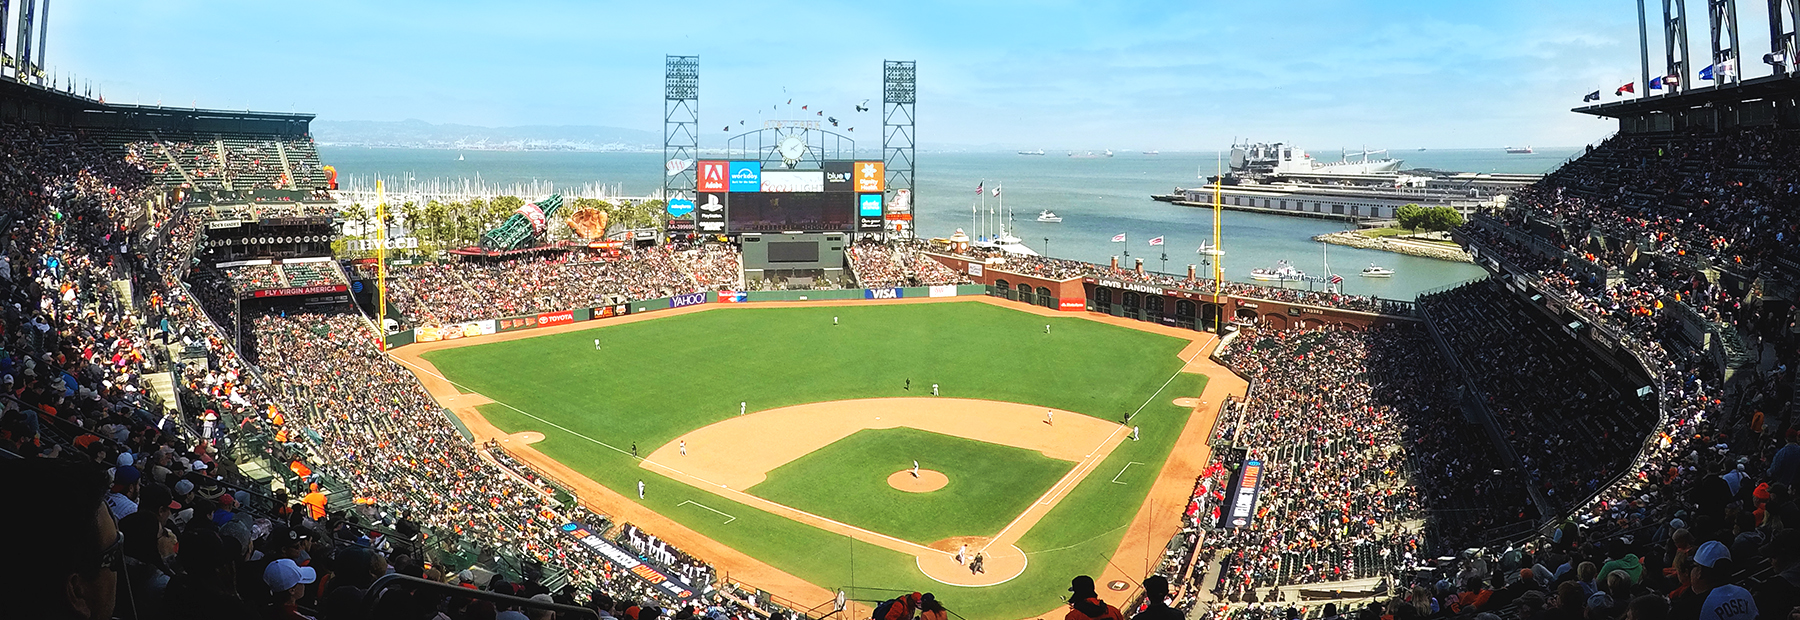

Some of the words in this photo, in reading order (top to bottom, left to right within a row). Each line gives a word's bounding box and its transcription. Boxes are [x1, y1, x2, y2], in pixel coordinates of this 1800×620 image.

[827, 172, 844, 180] blue
[705, 181, 723, 189] Adobe
[761, 180, 793, 192] Coors
[347, 236, 419, 251] nuveen
[278, 288, 304, 296] VIRGIN
[304, 286, 337, 294] AMERICA
[870, 288, 898, 299] VISA
[1123, 283, 1163, 295] LANDING
[672, 292, 707, 308] YAHOO!
[548, 313, 573, 323] TOYOTA
[596, 542, 641, 569] FRANCISCO
[631, 563, 668, 584] GIANTS
[1714, 598, 1750, 620] POSEY
